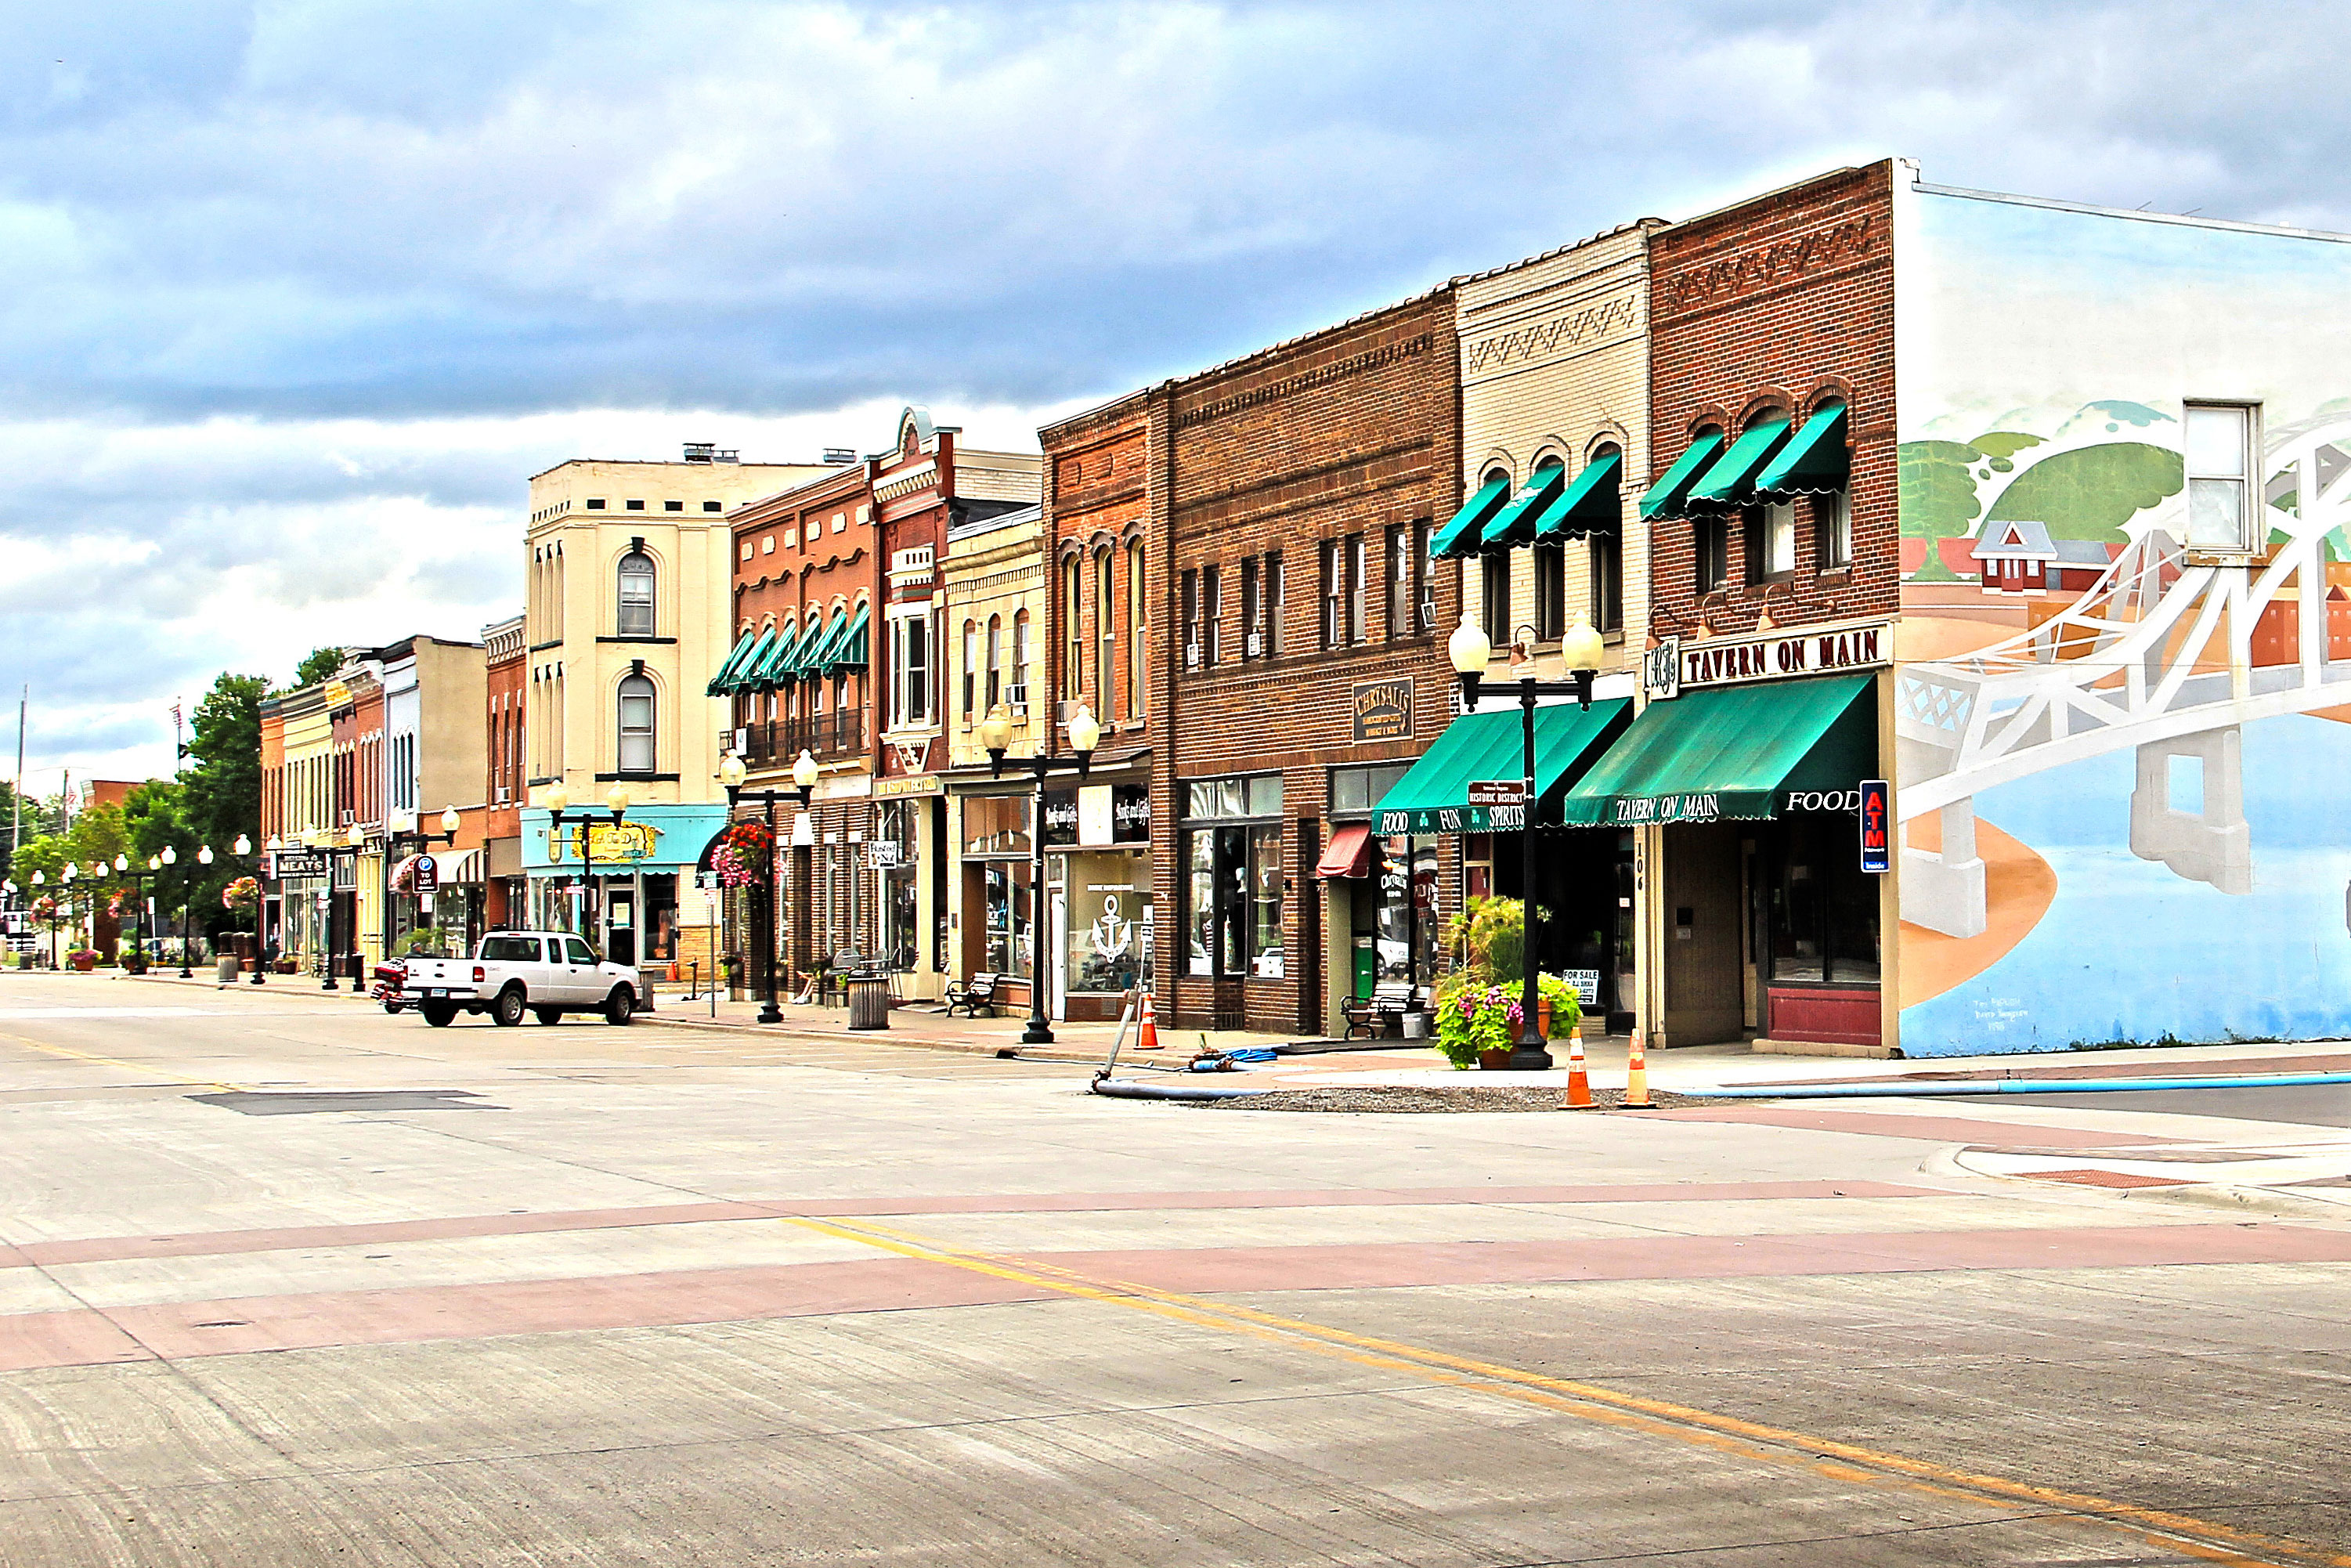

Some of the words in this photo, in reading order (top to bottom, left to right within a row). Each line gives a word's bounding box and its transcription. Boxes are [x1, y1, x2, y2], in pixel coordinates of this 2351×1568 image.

[1688, 643, 1766, 681] TAVERN
[1777, 640, 1805, 672] ON
[1818, 630, 1879, 667] MAIN
[1469, 793, 1496, 803] HISTORIC
[1497, 793, 1523, 803] DISTRICT
[1616, 797, 1657, 821] TAVERN
[1660, 795, 1679, 818] ON
[1681, 793, 1720, 816] MAIN
[1785, 790, 1861, 811] FOOD
[1381, 811, 1409, 832] FOOD
[1439, 808, 1462, 830] FUN
[1489, 804, 1526, 828] SPIRITS
[1865, 791, 1885, 847] ATM
[279, 861, 323, 872] MEATS
[1564, 970, 1577, 979] FOR
[1579, 970, 1598, 979] SALE
